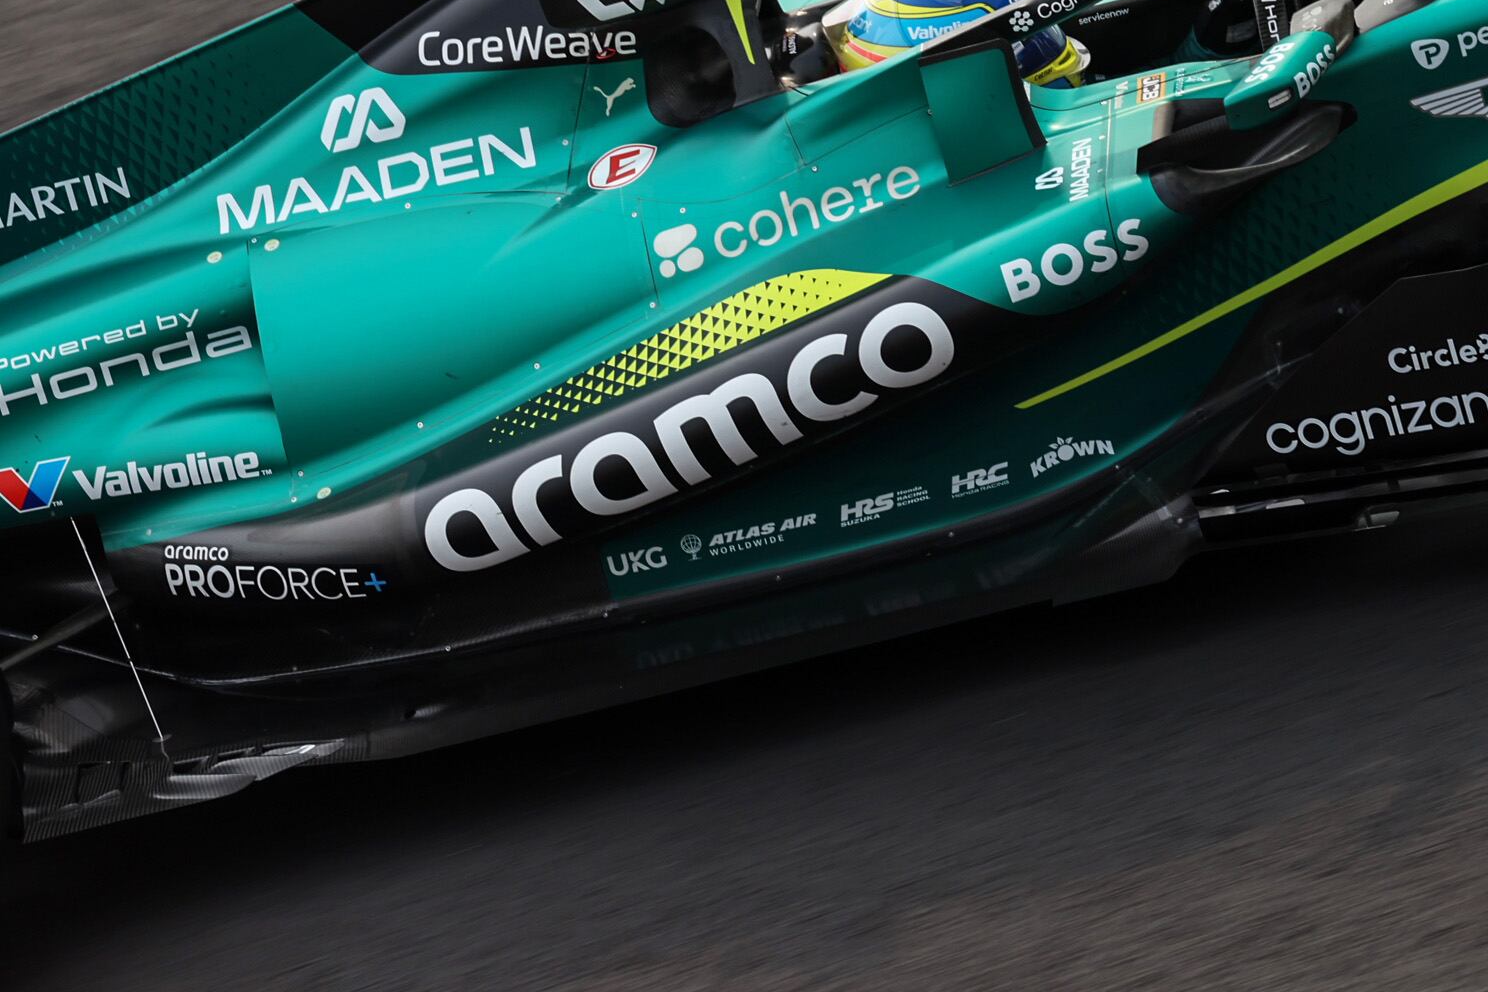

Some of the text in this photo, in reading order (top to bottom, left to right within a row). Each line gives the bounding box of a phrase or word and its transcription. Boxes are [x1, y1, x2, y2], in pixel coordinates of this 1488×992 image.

[1078, 8, 1130, 26] servicenow
[1264, 4, 1281, 43] Hon
[418, 25, 637, 66] CoreWeave
[1245, 42, 1295, 84] BOSS
[1294, 44, 1335, 98] BOSS
[216, 126, 537, 234] MAADEN
[1069, 137, 1092, 202] MAADEN
[0, 167, 131, 229] ARTIN
[714, 165, 921, 258] cohere
[1000, 218, 1149, 303] BOSS
[156, 309, 199, 331] by
[0, 325, 253, 416] Honda
[424, 302, 955, 573] aramco
[1030, 437, 1115, 478] KROWN
[72, 451, 260, 500] Valvoline
[897, 485, 923, 496] Honda
[952, 462, 1009, 495] HRC
[840, 492, 895, 522] HRS
[840, 513, 881, 528] SUZUKA
[709, 513, 817, 547] ATLAS AIR
[709, 534, 785, 557] WORLDWIDE
[164, 544, 230, 562] aramco
[606, 546, 669, 576] UKG
[165, 562, 388, 601] PROFORCE+
